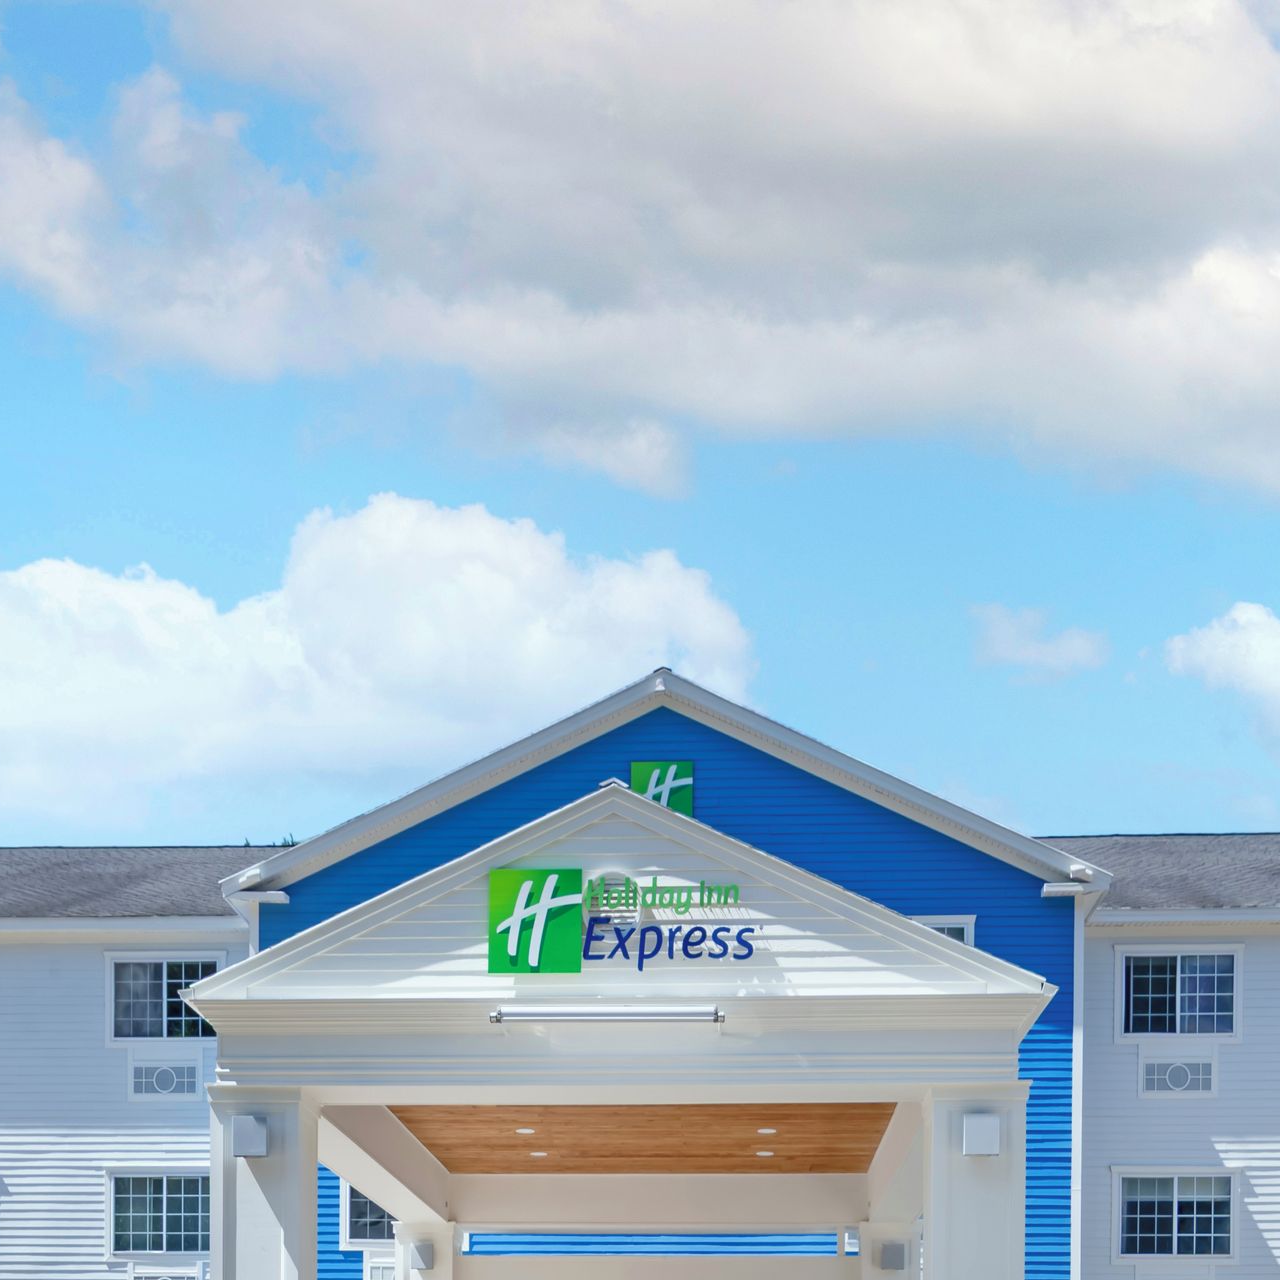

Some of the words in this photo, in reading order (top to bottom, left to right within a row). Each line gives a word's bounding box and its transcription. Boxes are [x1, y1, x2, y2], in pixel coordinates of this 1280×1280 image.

[495, 873, 583, 967] H
[584, 875, 693, 916] Holiday
[699, 879, 740, 908] Inn
[582, 916, 756, 972] Express
